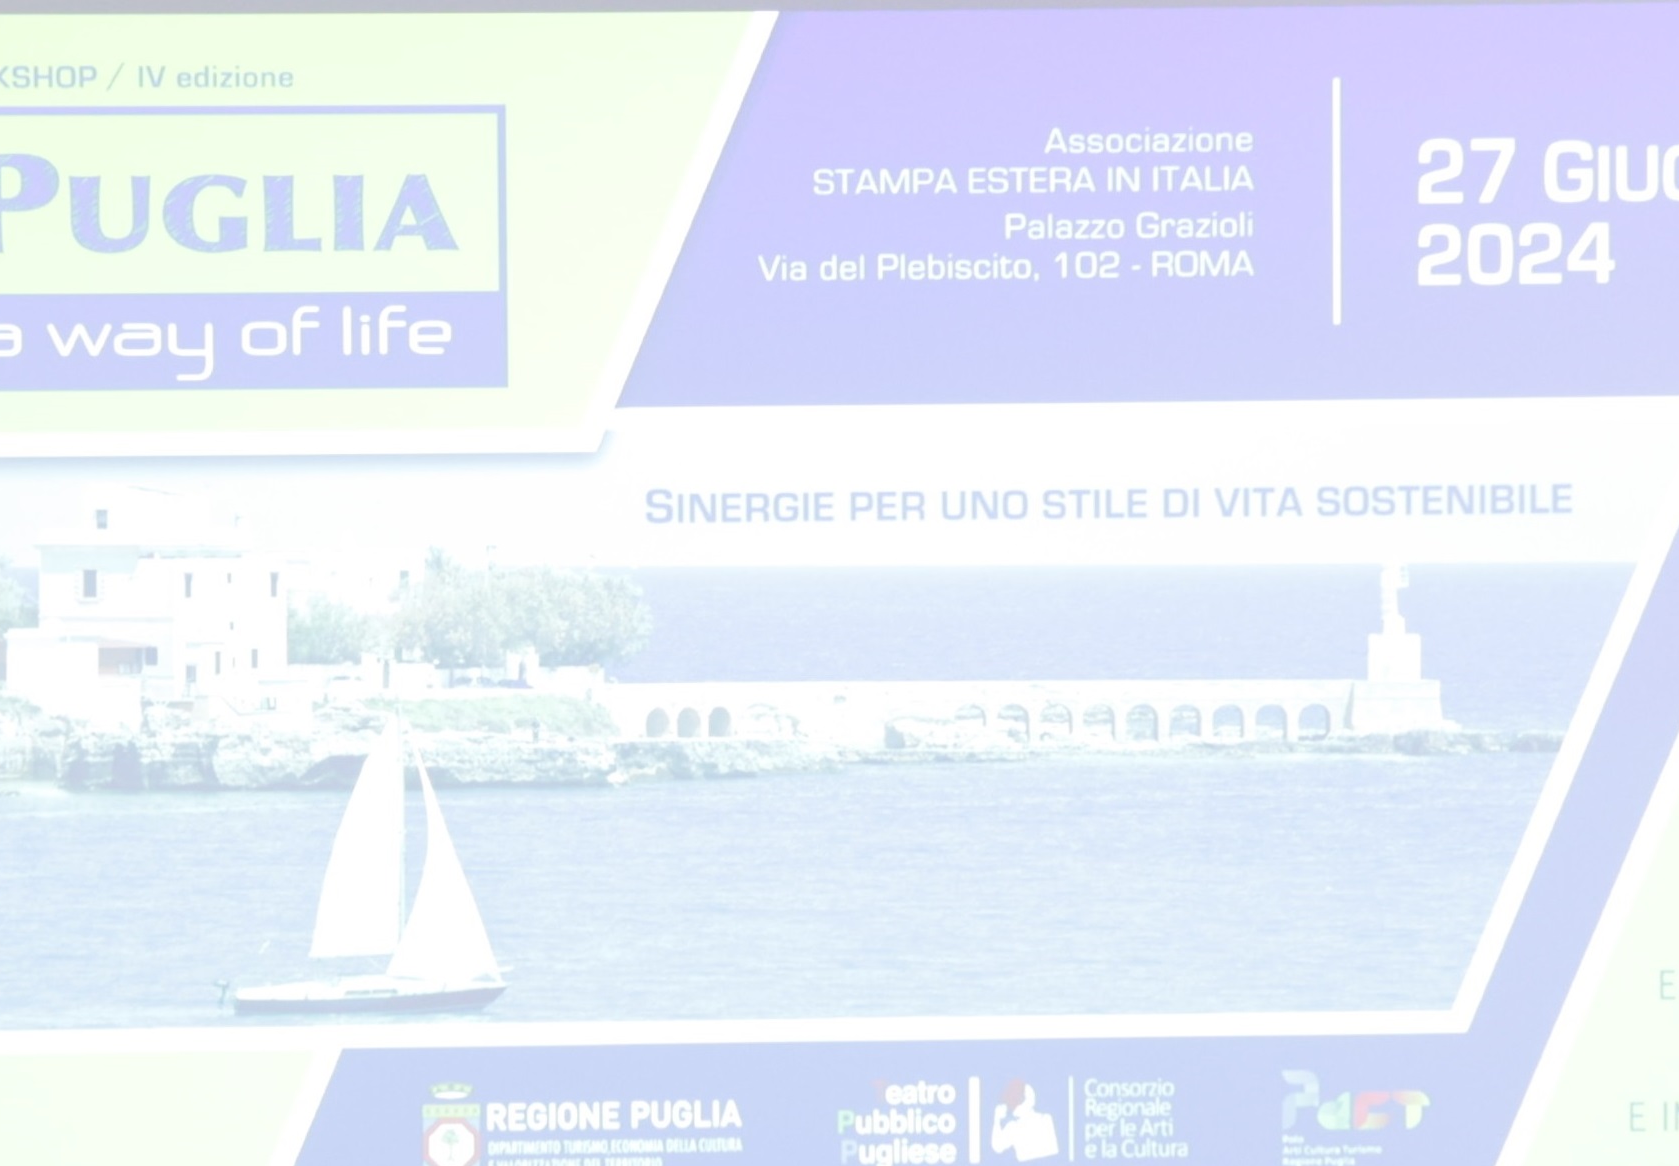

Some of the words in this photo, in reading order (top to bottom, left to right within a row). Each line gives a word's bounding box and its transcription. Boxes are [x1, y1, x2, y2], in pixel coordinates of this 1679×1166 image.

[137, 64, 168, 89] IV
[176, 64, 295, 89] edizione
[1043, 126, 1254, 154] Associazione
[811, 166, 957, 196] STAMPA
[966, 164, 1096, 195] ESTERA
[1106, 165, 1141, 193] IN
[1150, 163, 1255, 192] ITALIA
[1415, 136, 1517, 205] 27
[1004, 212, 1125, 240] Palazzo
[1133, 210, 1254, 239] Grazioli
[757, 254, 809, 282] Via
[818, 252, 866, 282] del
[875, 251, 1041, 285] Plebiscito,
[1053, 250, 1121, 280] 102
[1150, 248, 1255, 279] ROMA
[1415, 220, 1616, 287] 2024
[48, 321, 215, 382] way
[240, 306, 320, 357] of
[341, 306, 453, 357] life
[644, 487, 835, 525] SINERGIE
[848, 490, 929, 523] PER
[939, 488, 1031, 522] UNO
[1040, 487, 1149, 521] STILE
[1161, 486, 1201, 520] DI
[1212, 485, 1305, 519] VITA
[1316, 483, 1575, 518] SOSTENIBILE
[1658, 969, 1677, 1001] E
[1084, 1077, 1176, 1099] Consorzio
[485, 1100, 621, 1132] REGIONE
[629, 1098, 744, 1130] PUGLIA
[838, 1108, 957, 1137] Pubblico
[1084, 1098, 1172, 1123] Regionale
[1628, 1101, 1647, 1133] E
[1139, 1117, 1175, 1138] Arti
[1121, 1137, 1189, 1159] Cultura
